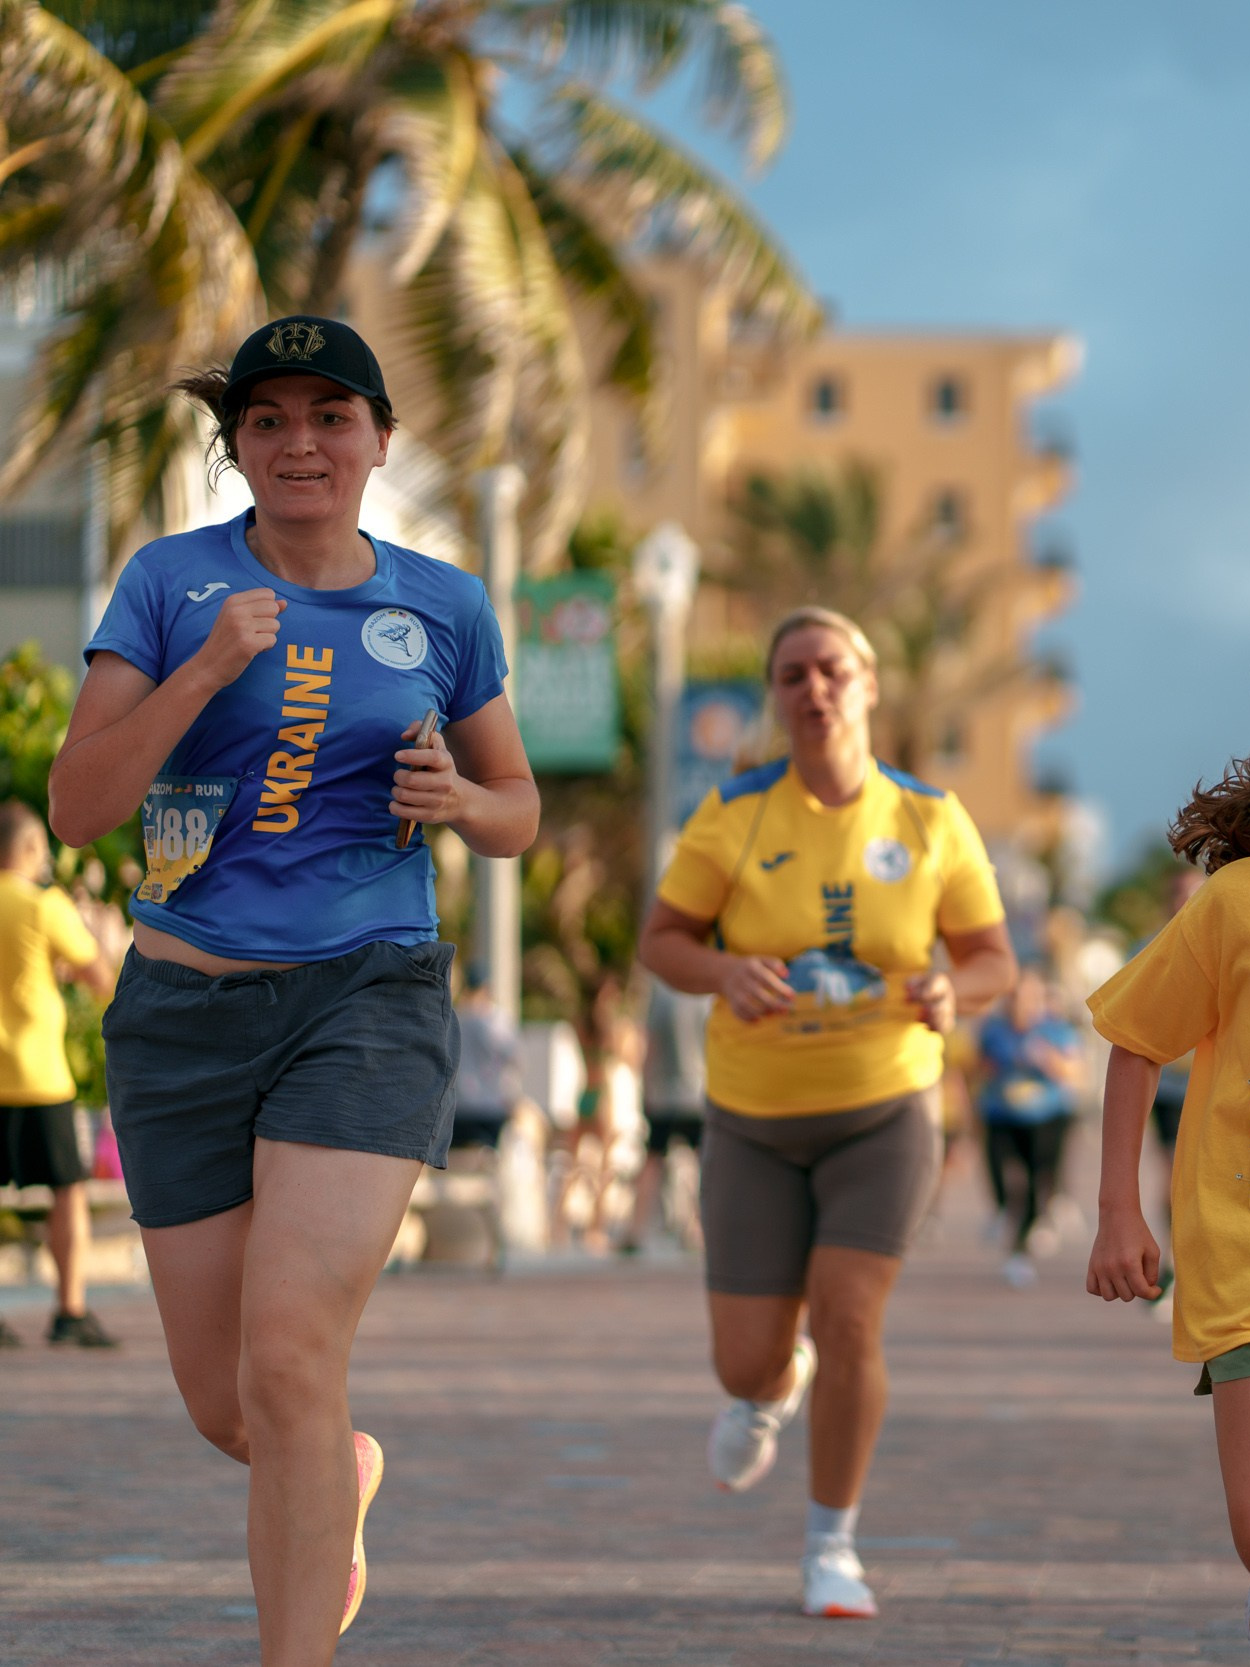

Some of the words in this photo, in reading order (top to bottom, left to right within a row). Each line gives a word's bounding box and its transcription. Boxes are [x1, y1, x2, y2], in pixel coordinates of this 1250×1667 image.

[368, 612, 387, 630] RAZOM
[409, 617, 421, 630] RUN
[252, 644, 334, 833] UKRAINE
[195, 784, 224, 797] RUN
